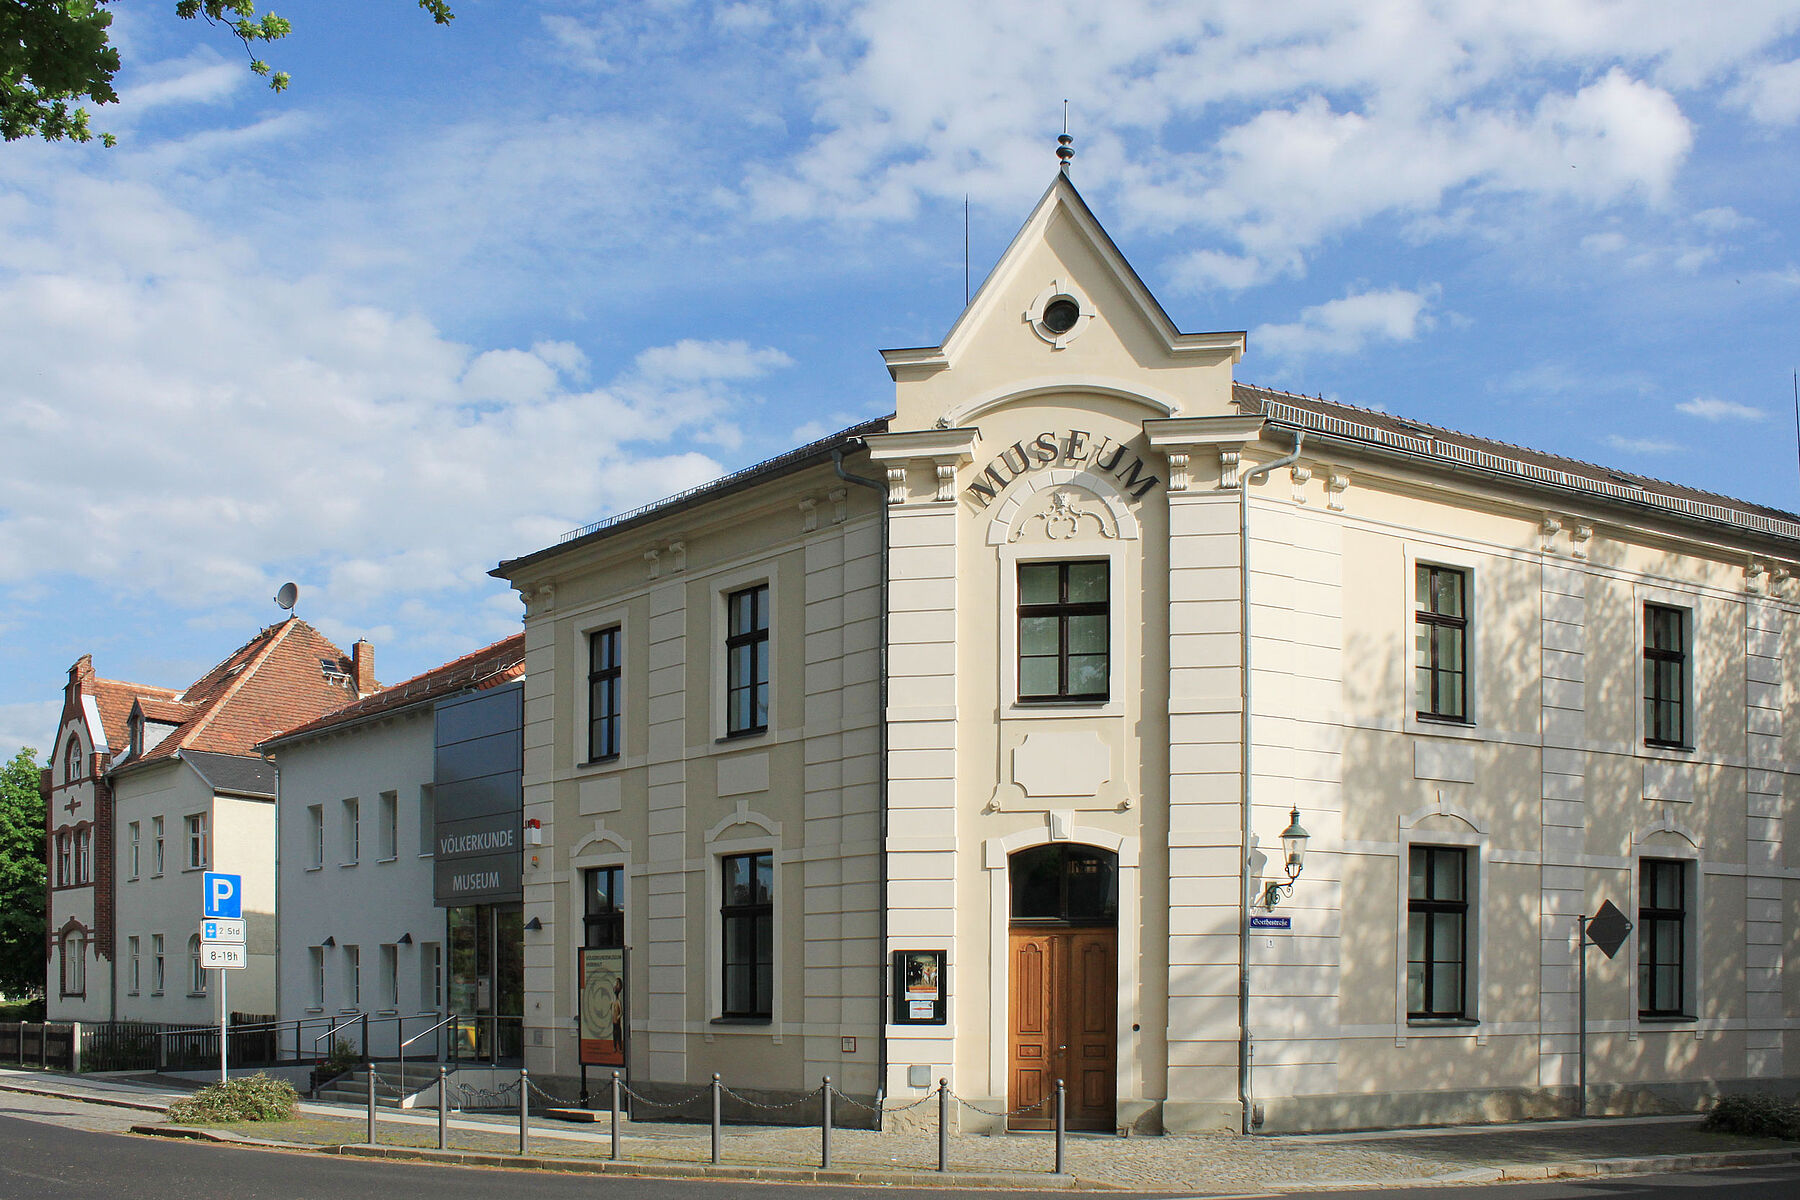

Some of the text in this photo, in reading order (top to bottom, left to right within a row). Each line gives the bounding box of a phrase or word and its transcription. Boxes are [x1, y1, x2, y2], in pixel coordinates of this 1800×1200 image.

[965, 429, 1160, 509] MUSEUM
[440, 830, 512, 854] VÖLKERKUNDE
[453, 872, 499, 891] MUSEUM
[213, 878, 233, 911] P
[219, 927, 240, 935] 2 Std
[210, 950, 238, 961] 8-18h
